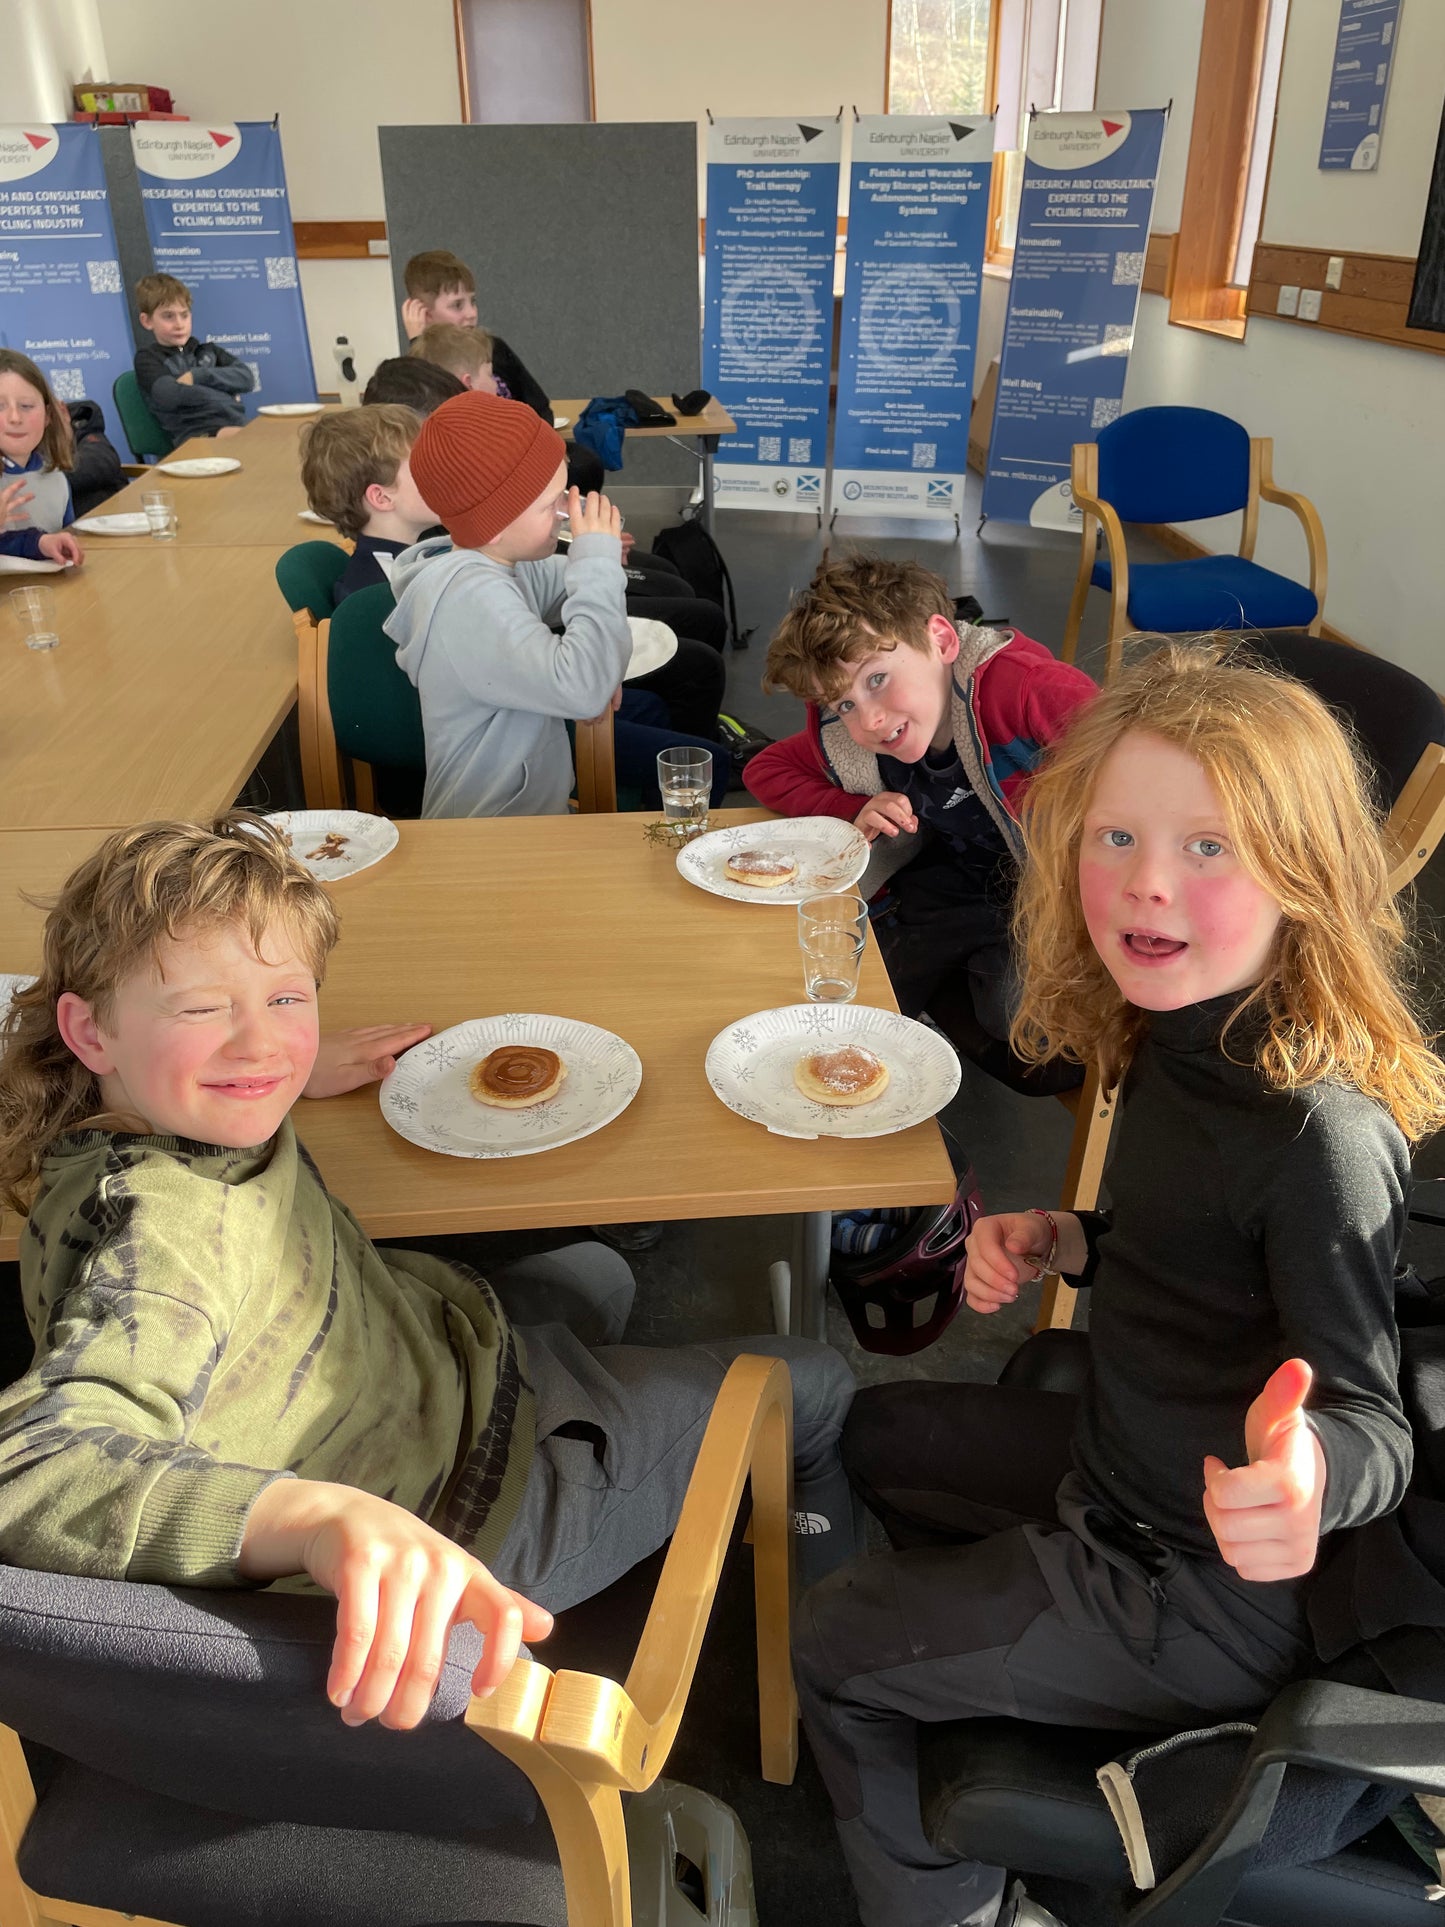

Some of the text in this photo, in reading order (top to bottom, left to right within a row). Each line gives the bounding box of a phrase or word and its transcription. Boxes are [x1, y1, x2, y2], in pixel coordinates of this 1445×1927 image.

[869, 133, 951, 146] Edinburgh Napier
[1034, 130, 1102, 141] Edinburgh Napier
[136, 139, 213, 151] Edinburgh Napier
[724, 135, 801, 148] Edinburgh Napier
[1059, 142, 1100, 151] UNIVERSITY
[753, 149, 800, 157] UNIVERSITY
[900, 148, 950, 156] UNIVERSITY
[736, 169, 811, 180] PhD studentship:
[869, 168, 973, 178] Flexible and Wearable
[746, 182, 801, 192] Trail therapy
[859, 181, 981, 192] Energy Storage Devices for
[1025, 180, 1071, 189] RESEARCH
[1072, 180, 1092, 189] AND
[11, 191, 33, 201] AND
[36, 190, 107, 201] CONSULTANCY
[142, 188, 285, 199] RESEARCH AND CONSULTANCY
[871, 194, 968, 204] Autonomous Sensing
[1048, 194, 1128, 203] EXPERTISE TO THE
[0, 204, 81, 215] PERTISE TO THE
[172, 202, 261, 213] EXPERTISE TO THE
[899, 205, 938, 217] Systems
[1045, 208, 1128, 218] CYCLING INDUSTRY
[1, 218, 84, 230] CLING INDUSTRY
[173, 215, 263, 226] CYCLING INDUSTRY
[1019, 238, 1061, 246] Innovation
[154, 248, 201, 256] Innovation
[1011, 307, 1064, 320] Sustainability
[25, 338, 95, 349] Academic Lead:
[206, 334, 246, 343] Academic
[1001, 379, 1042, 391] Well Being
